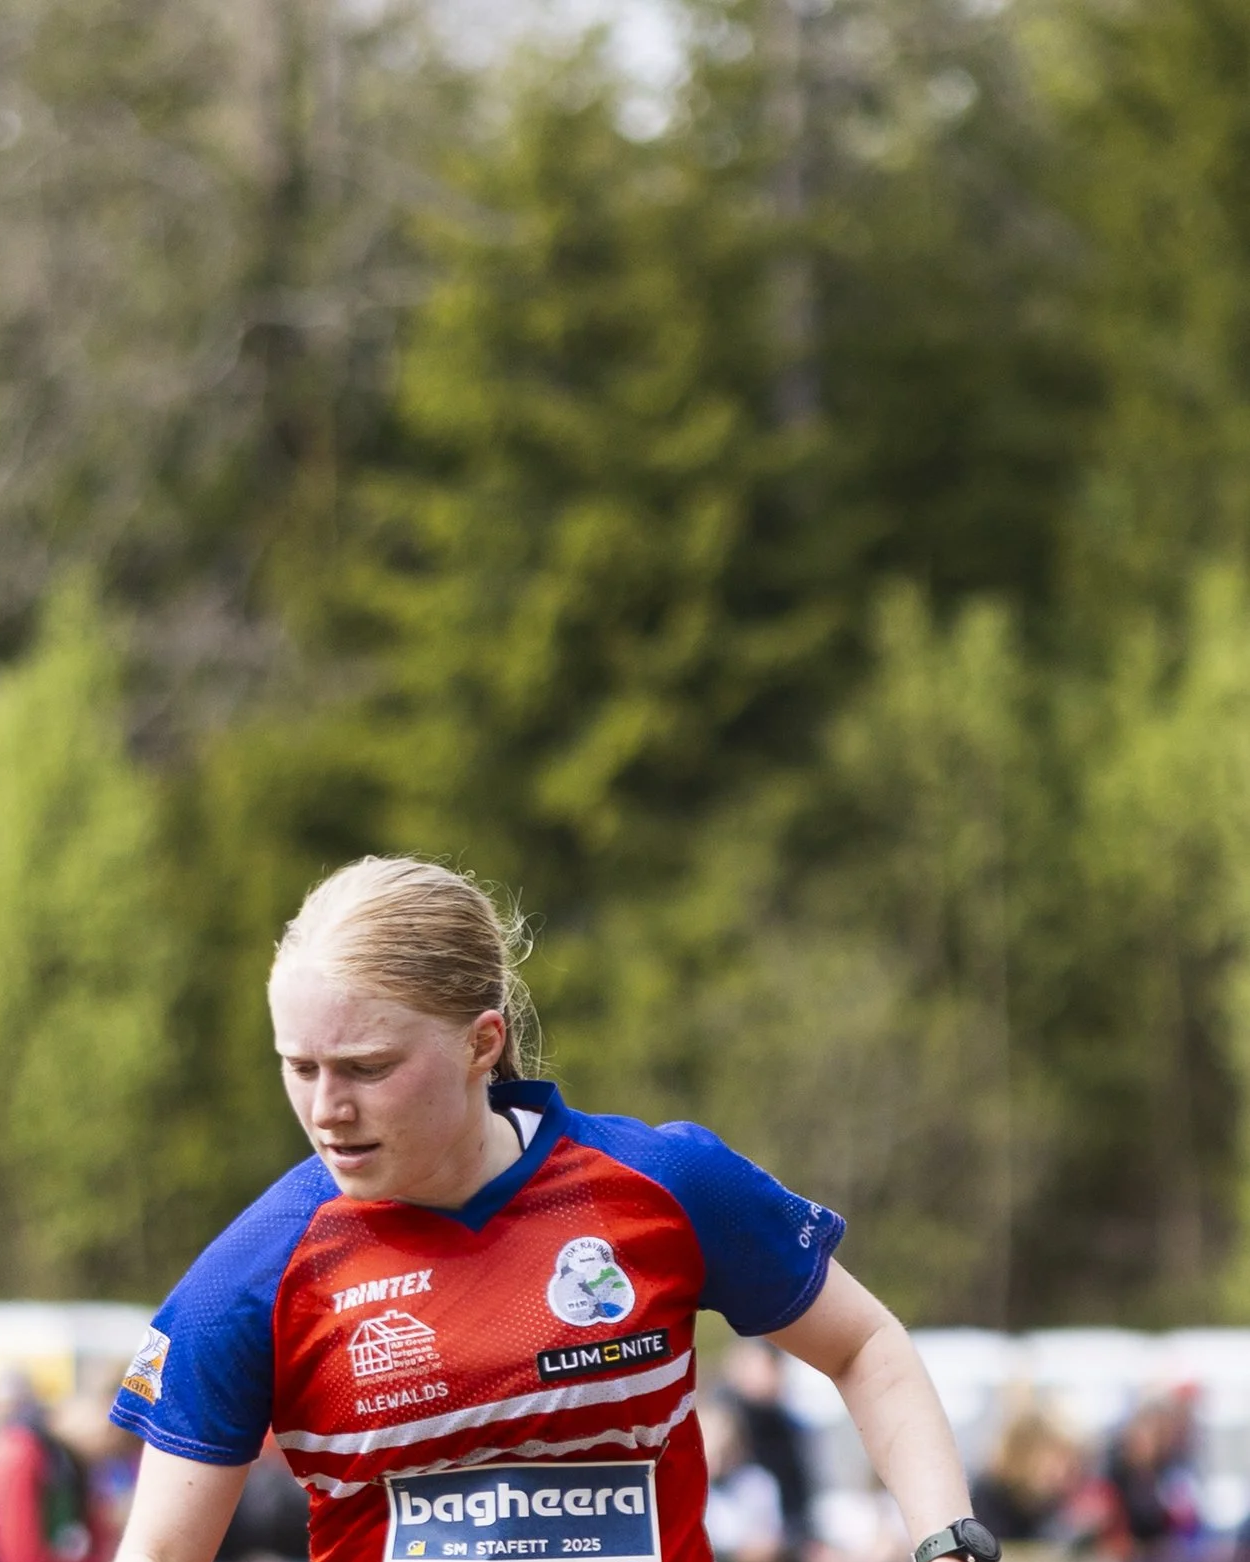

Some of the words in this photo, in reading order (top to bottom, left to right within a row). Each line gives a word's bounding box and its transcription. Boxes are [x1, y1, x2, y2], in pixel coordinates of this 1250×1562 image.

[332, 1269, 433, 1314] TRIMTEX
[355, 1381, 449, 1415] ALEWALDS
[400, 1483, 645, 1527] bagheera
[443, 1542, 467, 1556] SM
[477, 1539, 548, 1555] STAFETT
[562, 1538, 602, 1552] 2025
